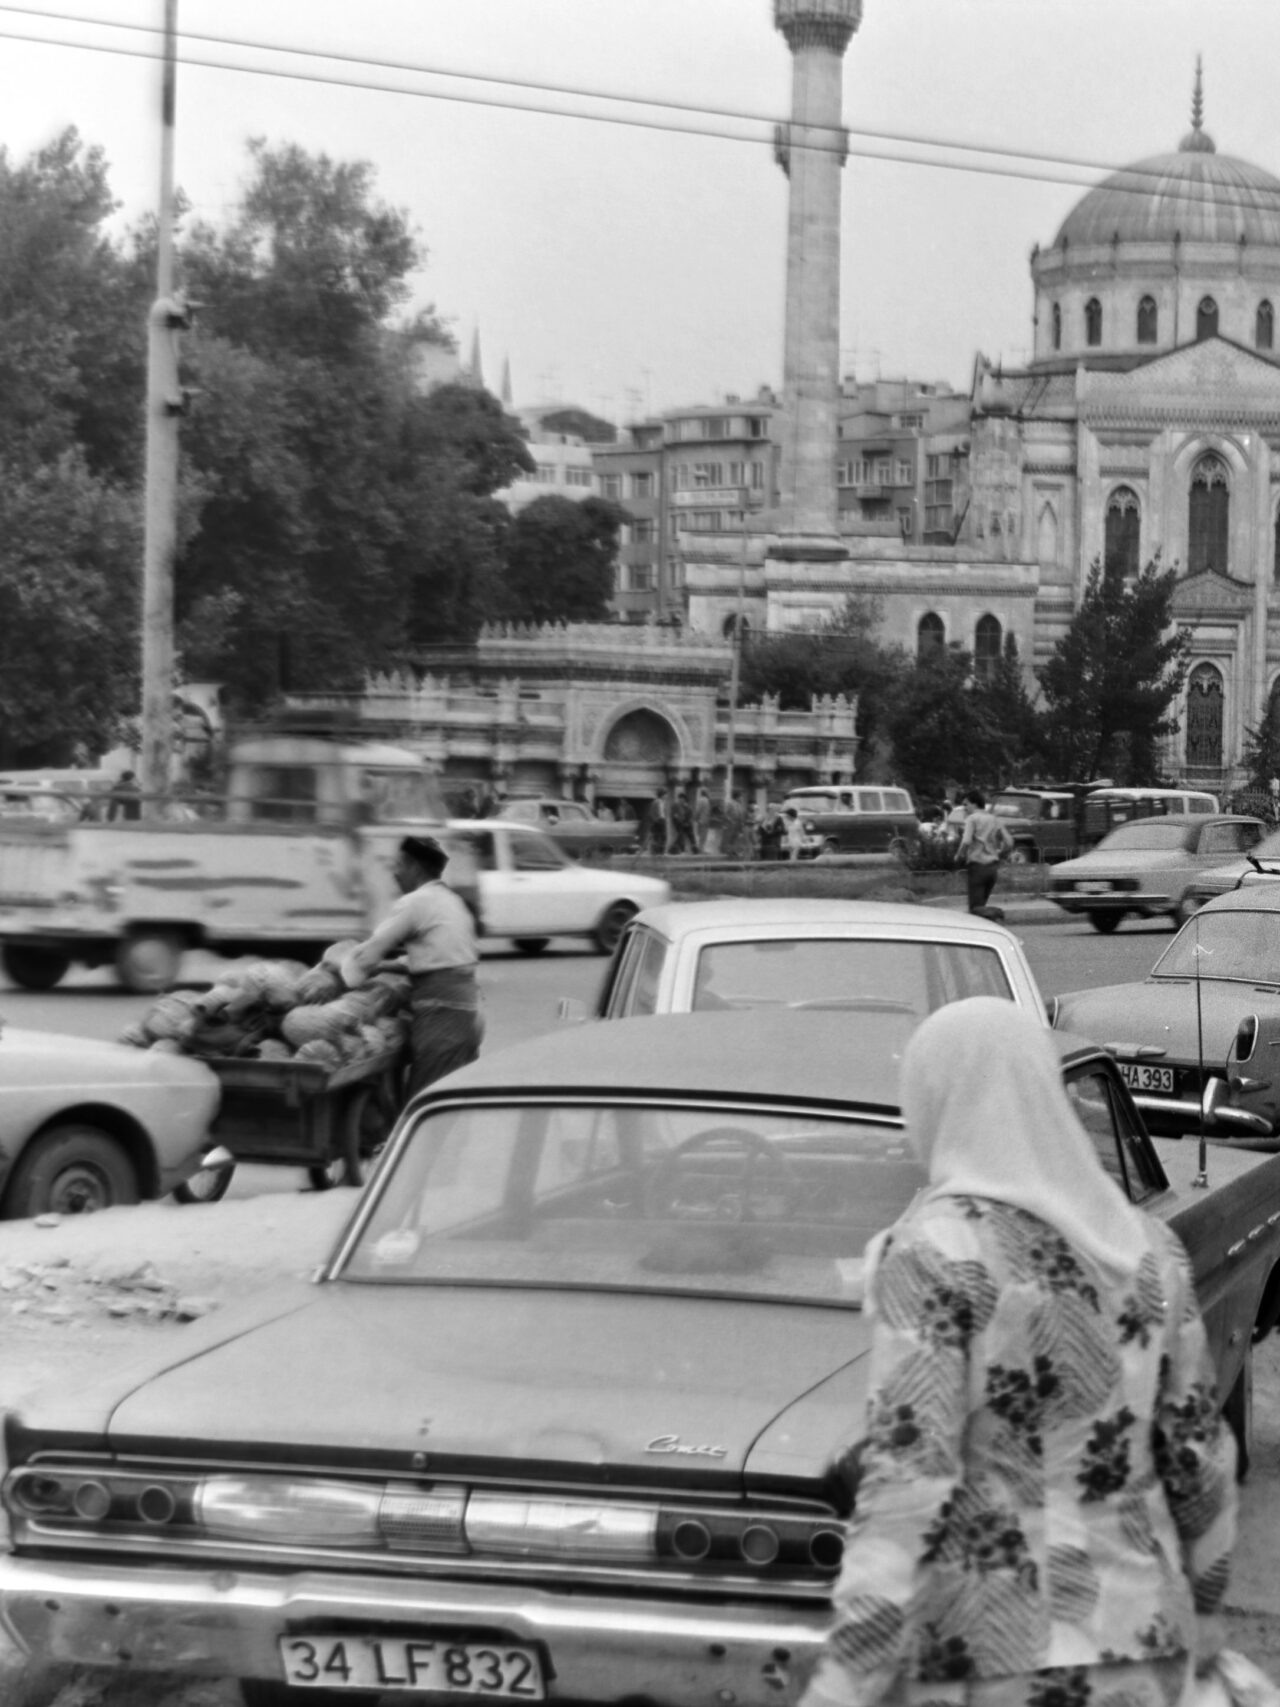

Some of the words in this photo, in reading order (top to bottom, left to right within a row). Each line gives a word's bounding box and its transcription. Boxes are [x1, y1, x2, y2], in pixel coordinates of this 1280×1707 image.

[1143, 1068, 1172, 1090] 393
[290, 1641, 352, 1682] 34
[374, 1642, 436, 1685] LF
[443, 1647, 536, 1695] 832
